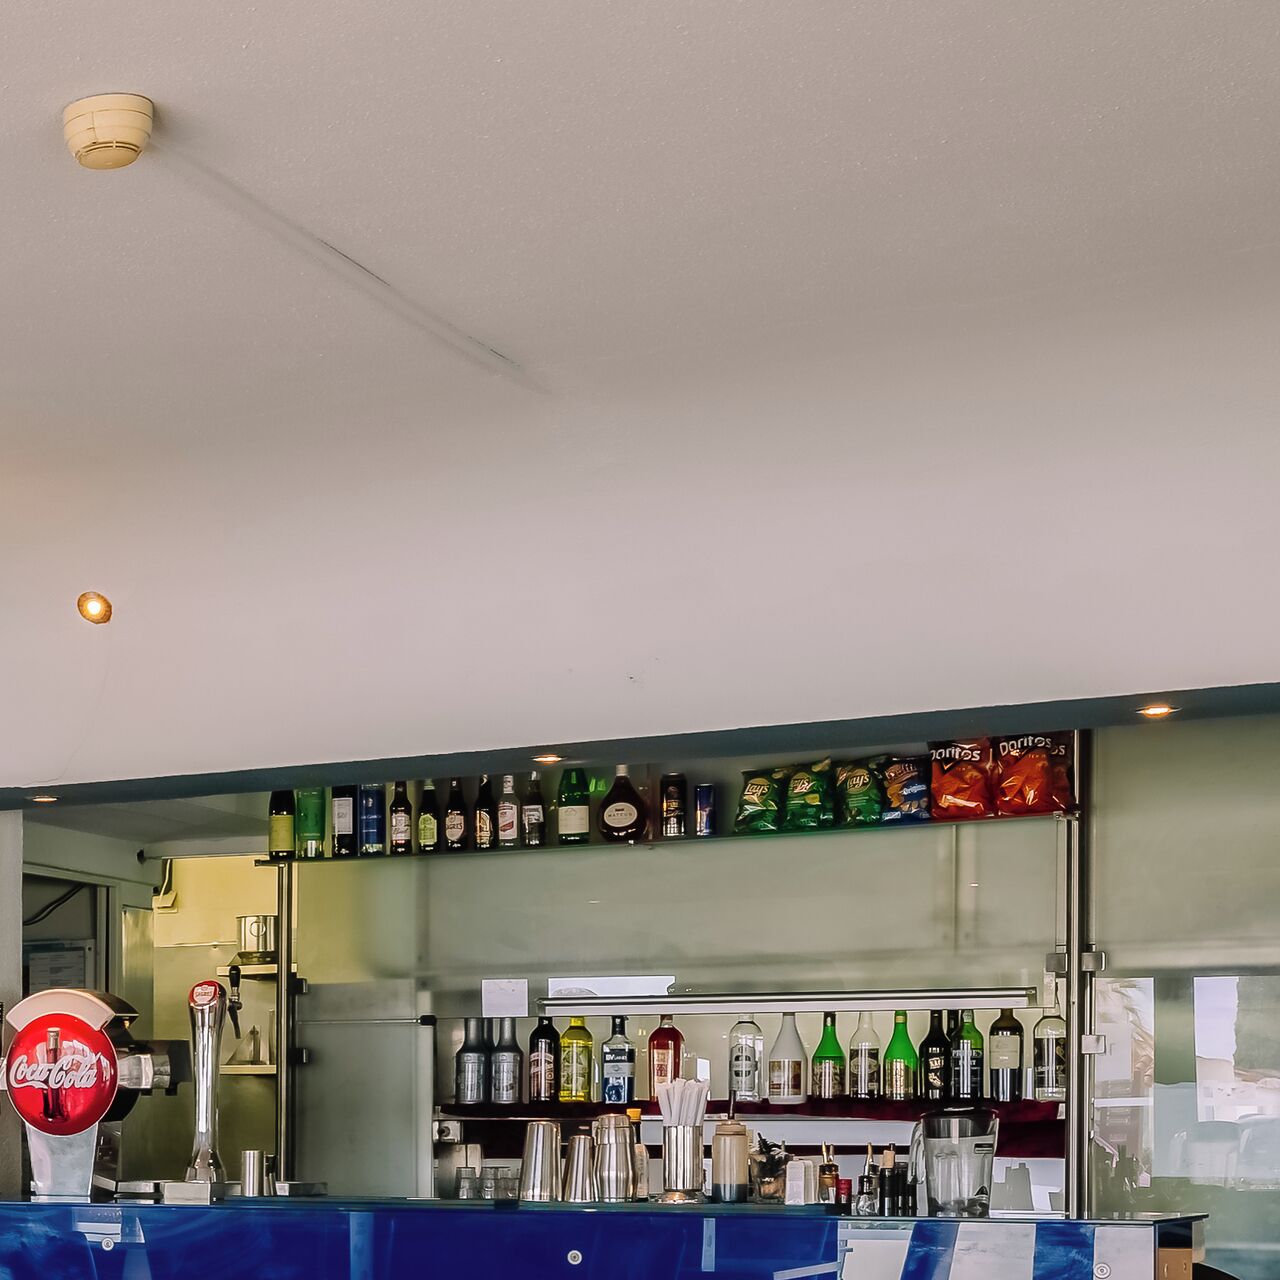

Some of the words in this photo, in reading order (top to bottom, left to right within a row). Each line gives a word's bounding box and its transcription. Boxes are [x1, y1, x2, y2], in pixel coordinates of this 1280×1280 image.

[930, 747, 981, 761] Doritos
[1000, 735, 1052, 756] Doritos
[10, 1053, 100, 1089] Coca-Cola
